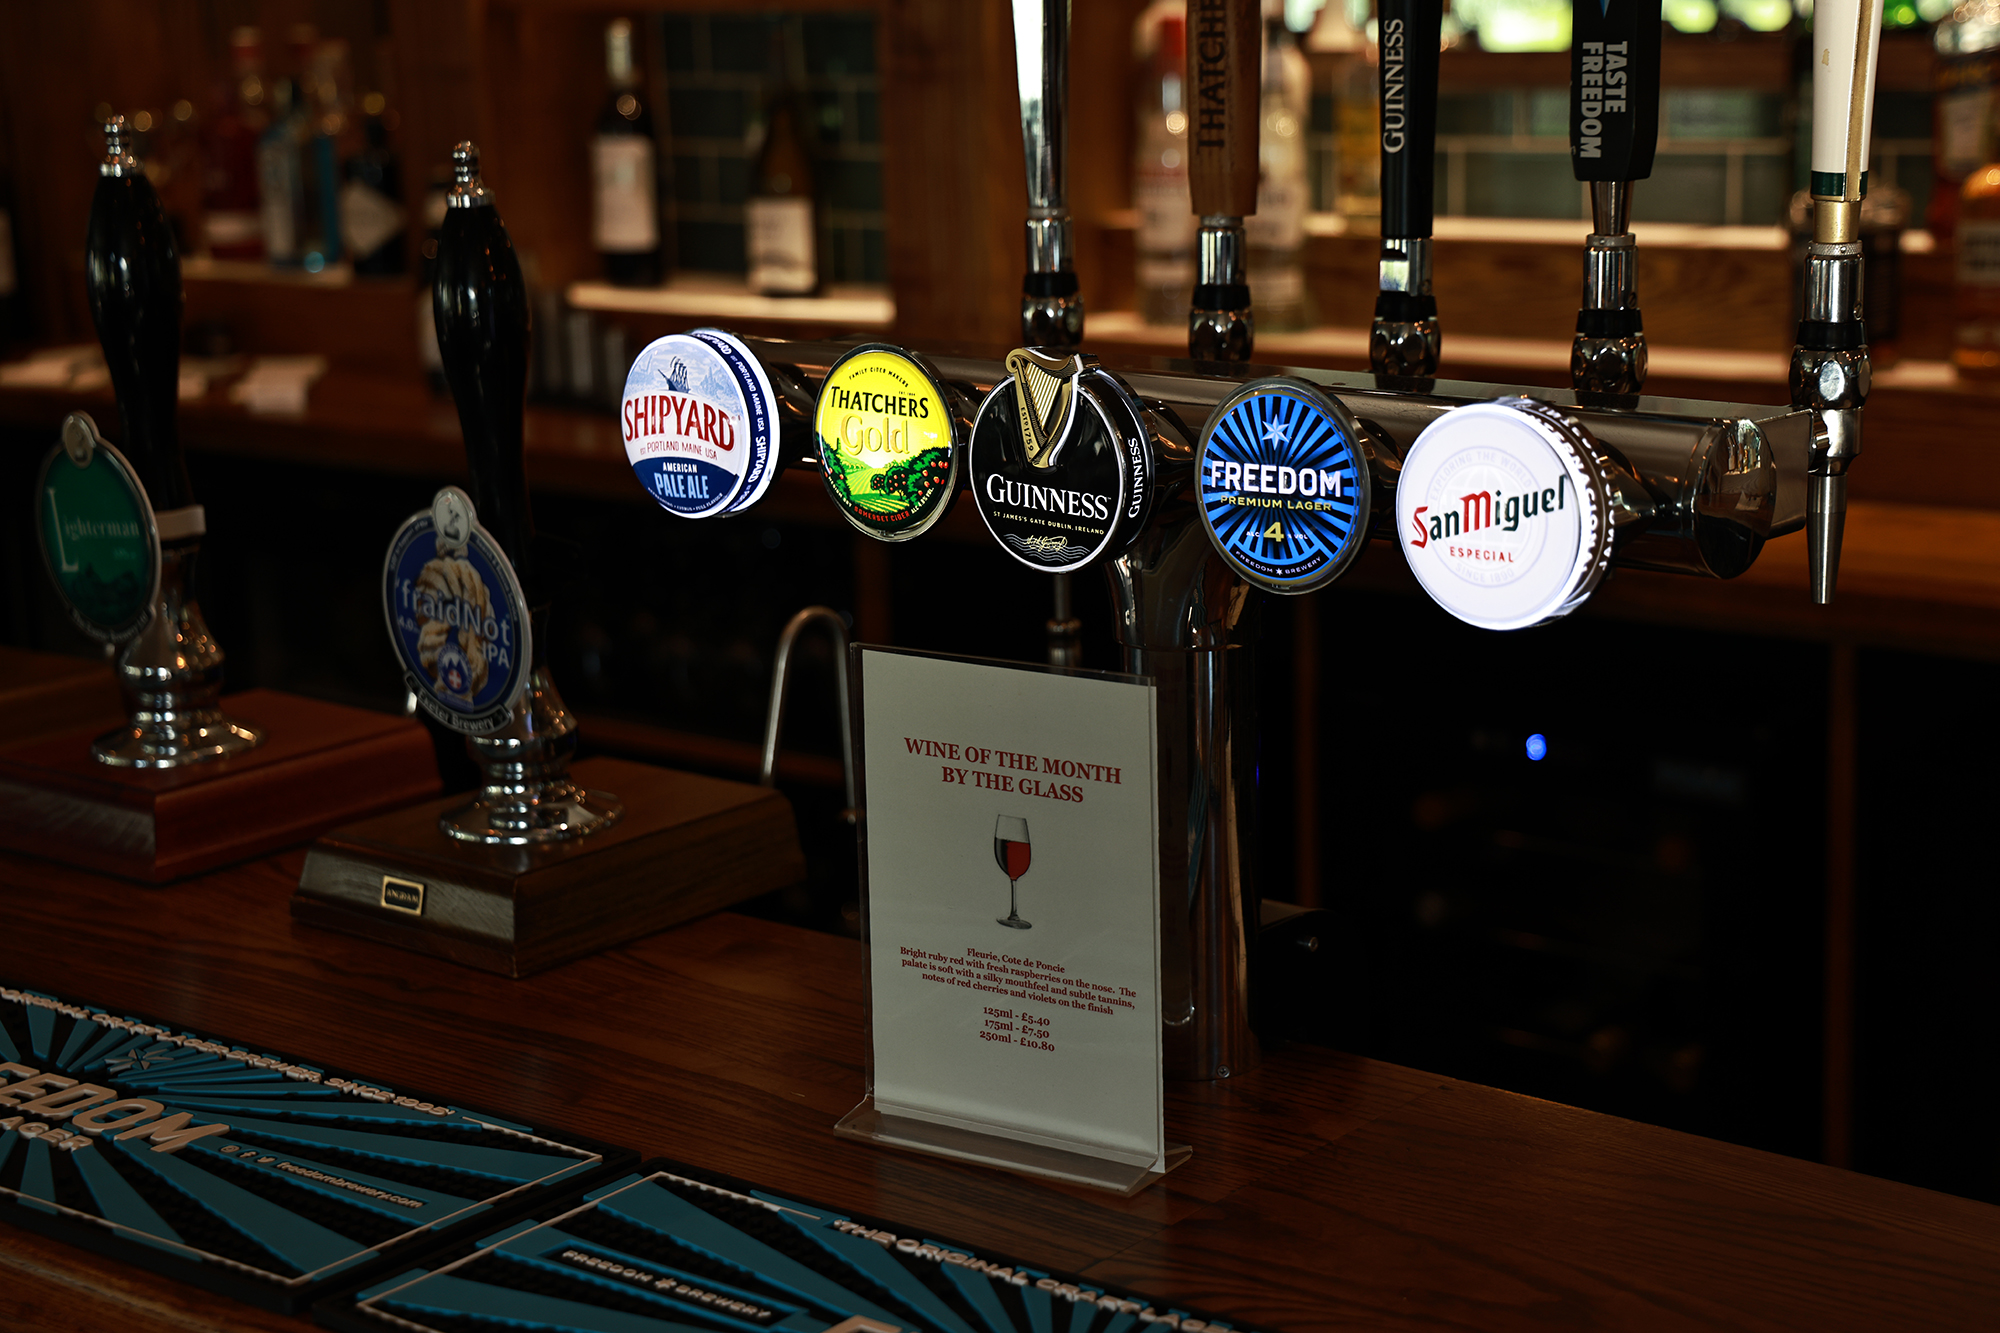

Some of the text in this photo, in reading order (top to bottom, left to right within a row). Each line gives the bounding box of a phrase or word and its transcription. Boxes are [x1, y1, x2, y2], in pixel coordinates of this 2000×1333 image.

[1382, 18, 1405, 154] GUINNESS
[1604, 40, 1628, 113] TASTE
[1580, 41, 1604, 158] FREEDOM
[736, 361, 756, 391] PORTLAND
[752, 393, 762, 415] MAINE
[757, 417, 766, 432] USA
[849, 368, 867, 380] FAMILY
[888, 371, 909, 388] MAKERS
[831, 386, 929, 418] THATCHERS
[624, 395, 735, 452] SHIPYARD
[841, 414, 910, 456] Gold
[1023, 428, 1034, 451] 1759
[647, 441, 680, 453] PORTLAND
[681, 443, 702, 456] MAINE
[705, 447, 718, 461] USA
[663, 462, 697, 473] AMERICAN
[748, 435, 767, 483] SHIPYARD
[654, 472, 686, 499] PALE
[688, 475, 710, 499] ALE
[1128, 437, 1144, 518] GUINNESS
[1211, 460, 1341, 497] FREEDOM
[1430, 451, 1532, 501] EXPLORING THE WORLD
[854, 506, 889, 522] SOMERSET
[890, 510, 910, 522] CIDER
[986, 473, 1109, 520] GUINNESS
[1220, 495, 1332, 511] PREMIUM LAGER
[45, 486, 140, 573] Lighterman
[1003, 512, 1028, 522] JAMES'S
[1030, 517, 1046, 526] GATE
[1075, 525, 1104, 535] IRELAND
[1263, 521, 1285, 542] 4
[1235, 550, 1322, 575] FREEDOM BREWERY
[1450, 546, 1515, 563] ESPECIAL
[1456, 563, 1486, 583] SINCE
[481, 639, 511, 669] IPA
[452, 714, 496, 731] Brewery
[904, 737, 1122, 784] WINE OF THE MONTH
[941, 766, 1084, 803] BY THE GLASS
[900, 946, 1137, 998] Bright ruby red with fresh raspberries on the nose. The
[967, 947, 1066, 974] Fleurie, Cote de Poncie
[901, 959, 928, 969] palate
[929, 962, 937, 971] is
[938, 965, 954, 975] soft
[955, 968, 974, 978] with
[983, 972, 1003, 984] silky
[1005, 977, 1049, 992] mouthfeel
[1050, 986, 1067, 996] and
[1069, 990, 1097, 1001] subtle
[1098, 994, 1135, 1010] tannins,
[922, 972, 1114, 1015] notes of red cherries and violets on the finish
[983, 1006, 1013, 1019] 125ml
[1021, 1012, 1050, 1026] £5.40
[984, 1018, 1013, 1031] 175ml
[1021, 1025, 1050, 1039] £7.50
[979, 1030, 1012, 1044] 250ml
[1020, 1037, 1055, 1052] £10.80
[156, 1031, 229, 1059] LAGER
[324, 1077, 396, 1104] SINCE
[275, 1161, 424, 1209] freedombrewery.com
[562, 1249, 772, 1319] FREEDOM BREWERY
[896, 1238, 1029, 1286] ORIGINAL
[1035, 1278, 1142, 1314] CRAFT
